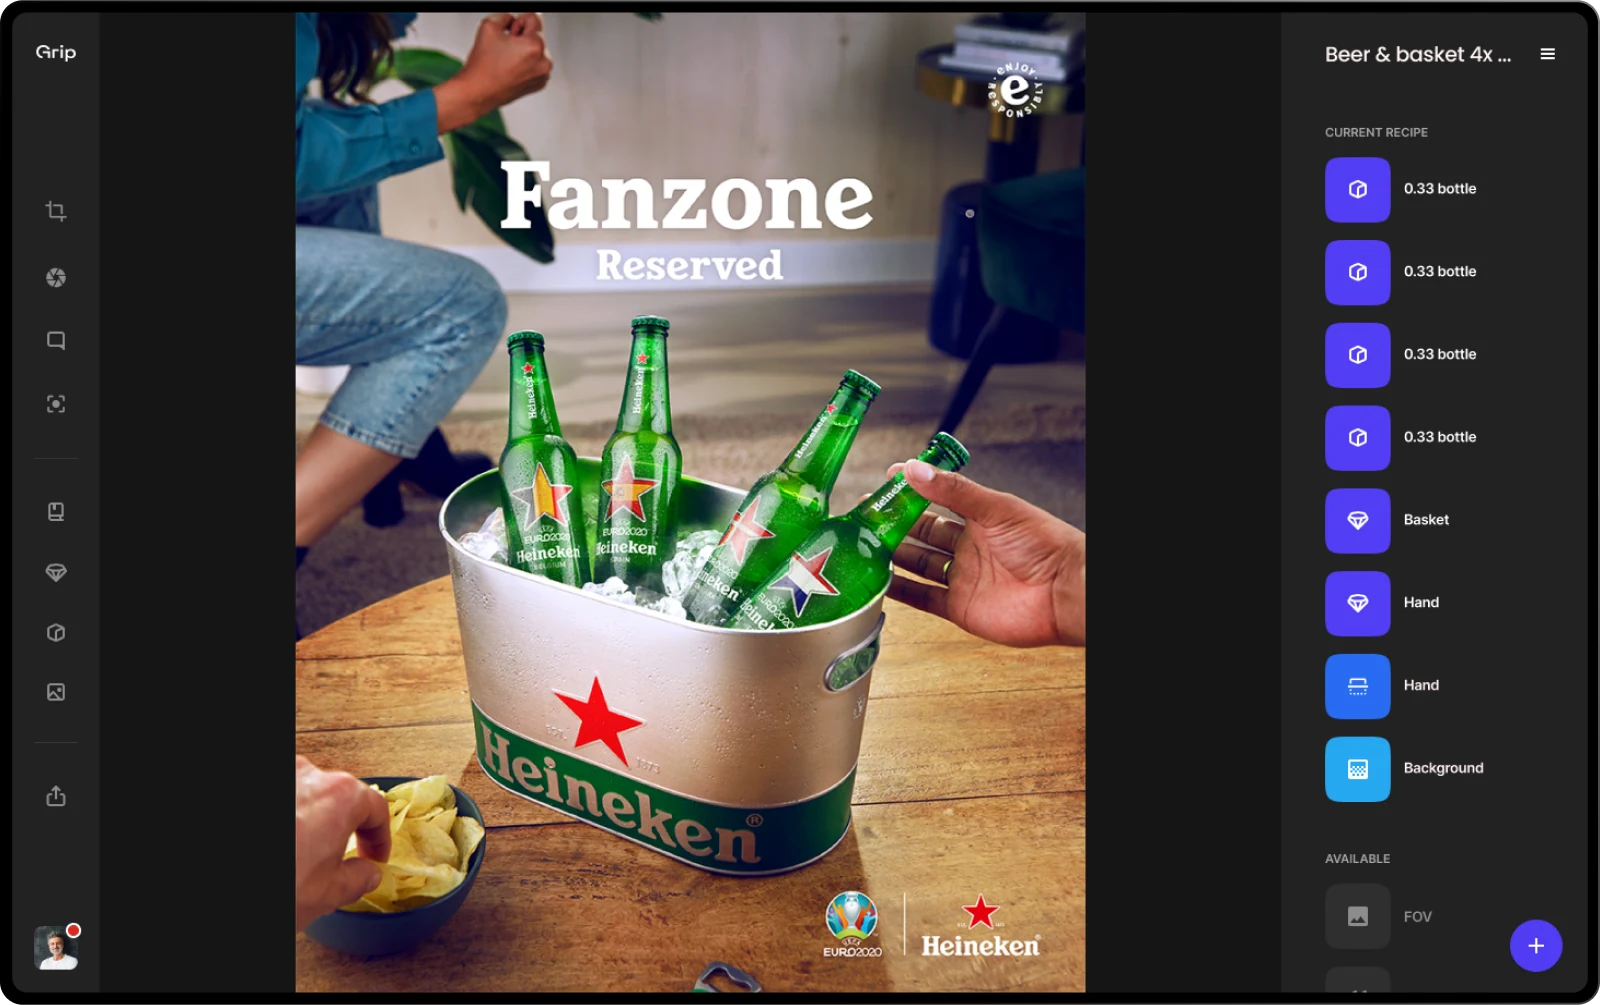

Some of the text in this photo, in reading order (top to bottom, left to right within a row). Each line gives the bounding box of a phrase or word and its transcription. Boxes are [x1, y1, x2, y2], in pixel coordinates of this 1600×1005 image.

[36, 44, 77, 62] Grip
[1325, 46, 1371, 63] Beer
[1375, 46, 1391, 63] &
[1396, 46, 1465, 63] basket
[1470, 46, 1494, 63] 4x
[1325, 127, 1428, 138] CURRENT RECIPE
[500, 160, 873, 231] Fanzone
[1404, 182, 1477, 195] 0.33 bottle
[596, 249, 784, 281] Reserved
[1404, 265, 1477, 278] 0.33 bottle
[1404, 348, 1477, 361] 0.33 bottle
[527, 374, 537, 419] Heineken
[633, 367, 644, 414] Heineken
[795, 414, 828, 459] Heineken
[1404, 430, 1477, 443] 0.33 bottle
[871, 479, 908, 512] Heineke
[1404, 513, 1450, 526] Basket
[602, 527, 648, 537] EURO2020
[516, 545, 580, 564] Heineken
[1404, 595, 1440, 609] Hand
[1404, 678, 1440, 692] Hand
[1404, 761, 1484, 777] Background
[479, 719, 761, 865] Heineken
[1325, 853, 1391, 864] AVAILABLE
[1404, 910, 1433, 923] FOV
[823, 947, 883, 958] EURO2020
[921, 935, 1041, 957] Heineken
